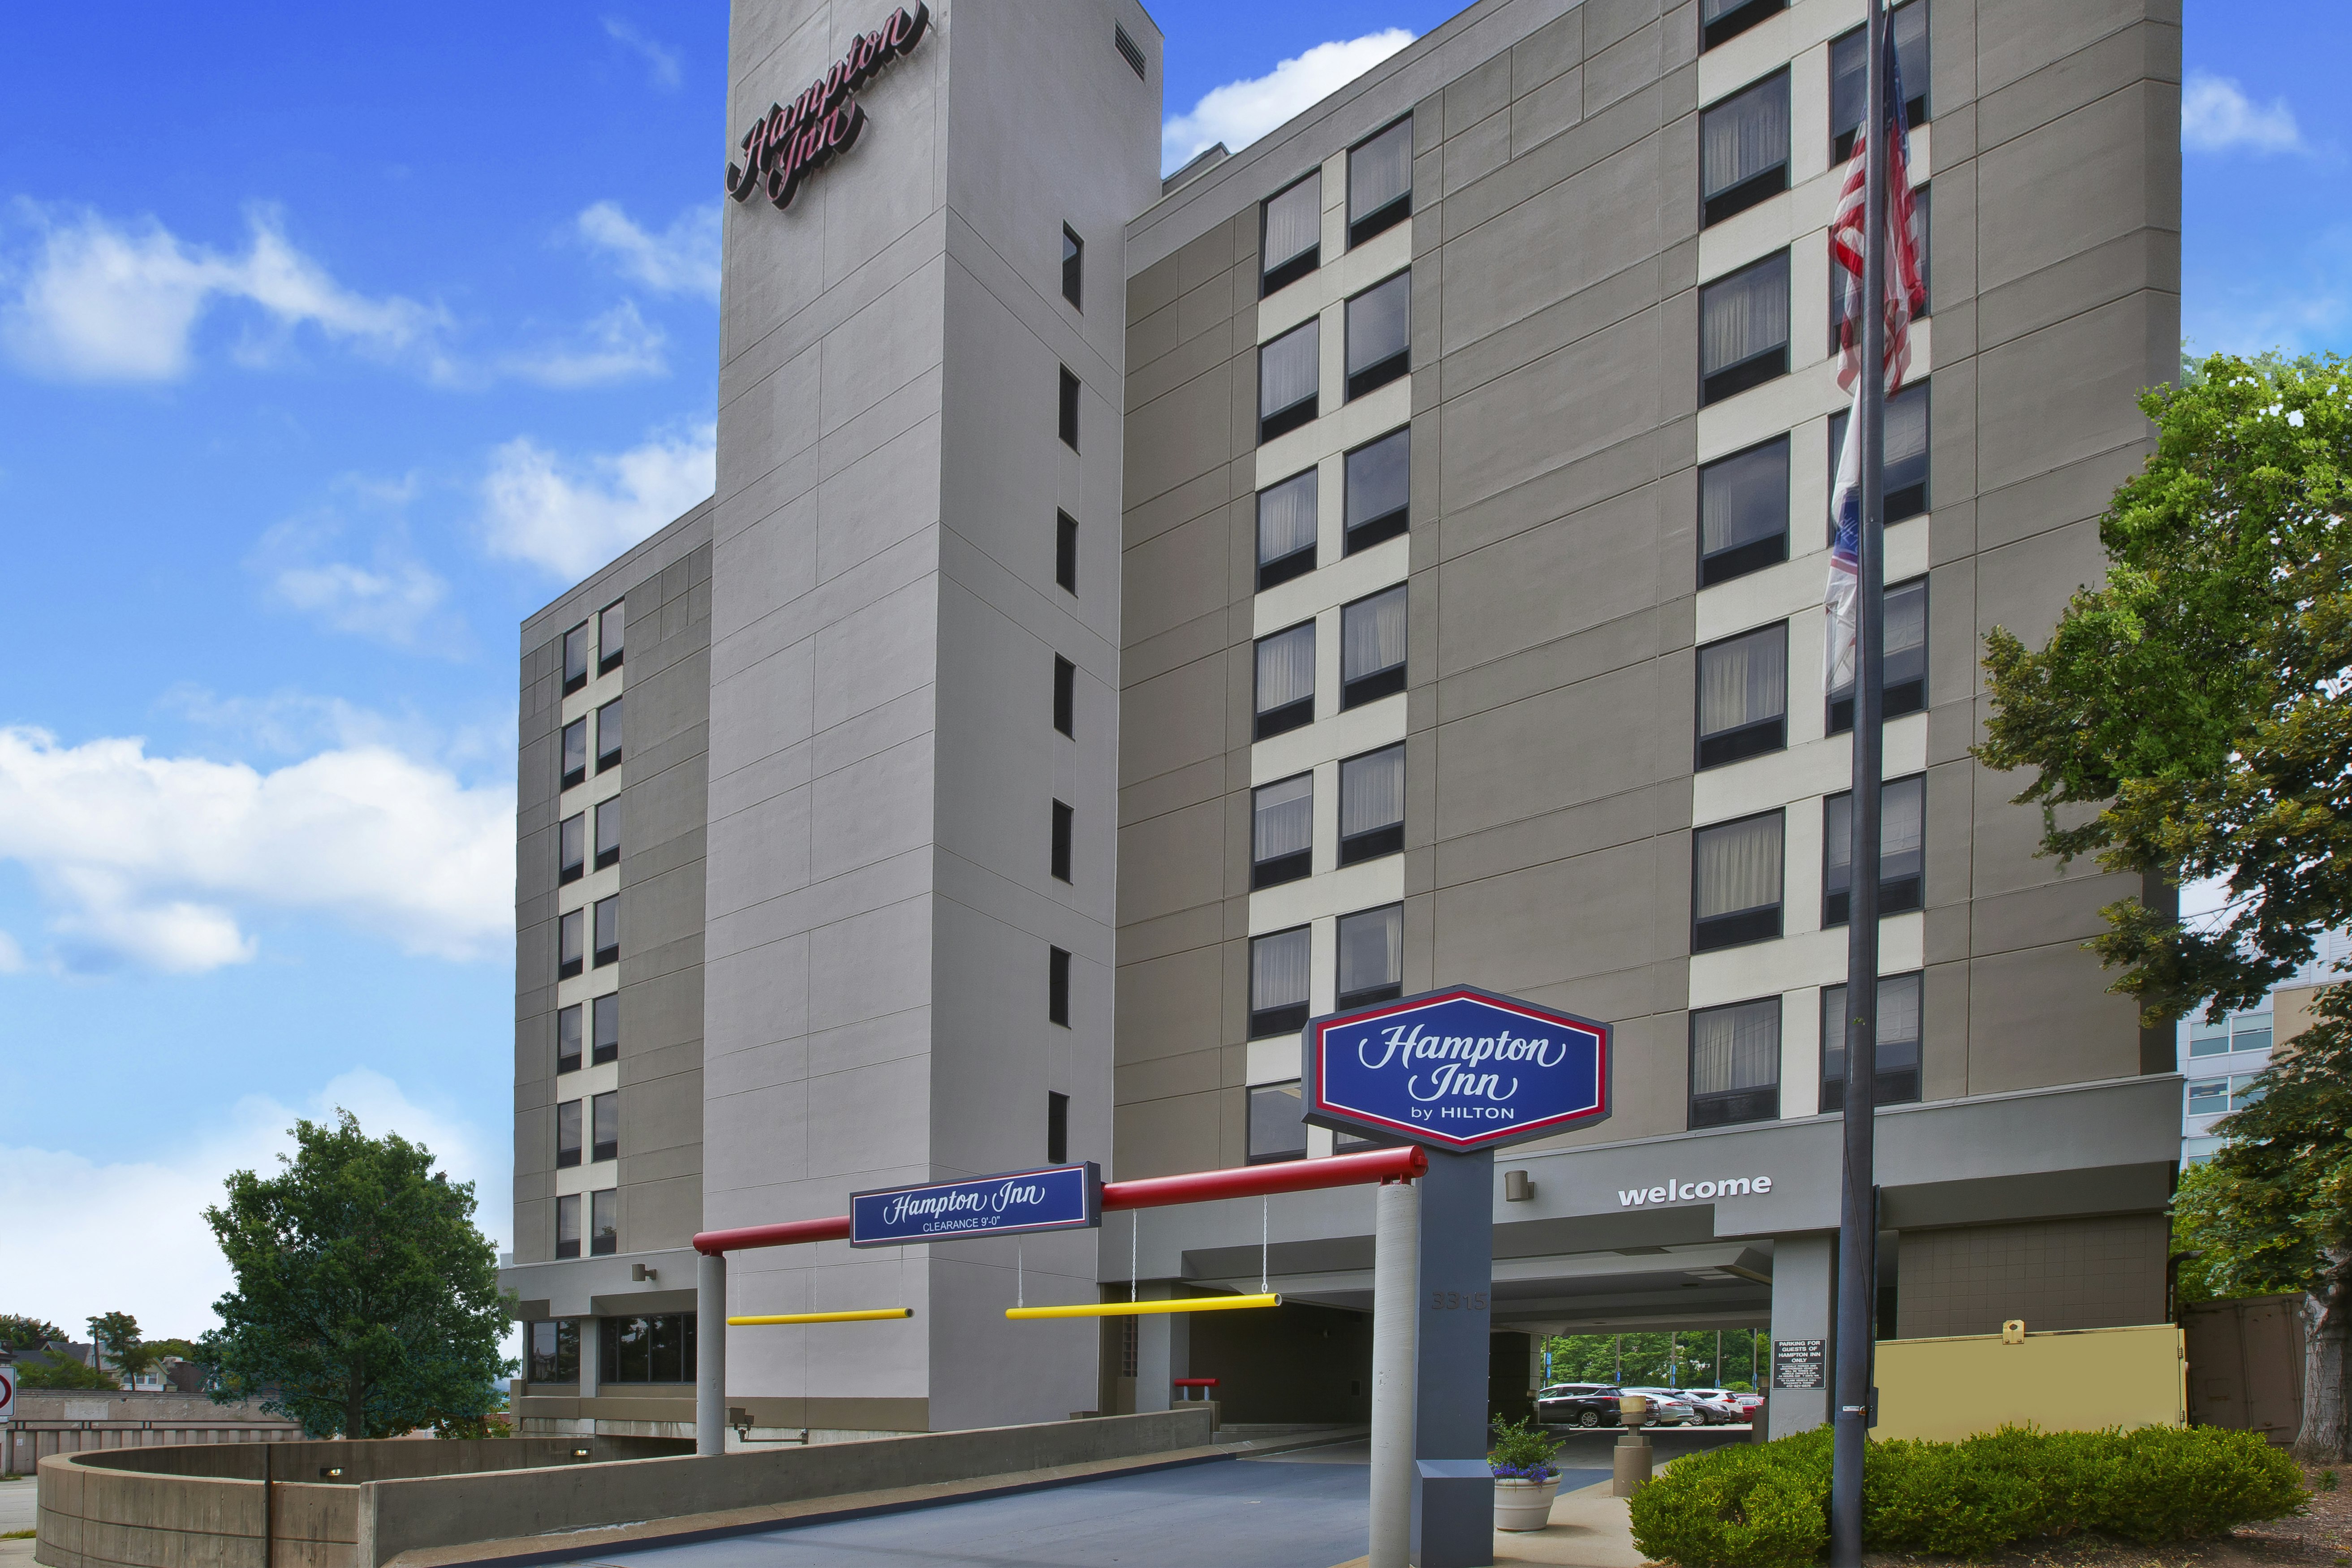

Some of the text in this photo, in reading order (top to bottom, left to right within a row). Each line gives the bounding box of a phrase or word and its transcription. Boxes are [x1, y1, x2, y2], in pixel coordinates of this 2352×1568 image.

[725, 0, 929, 202] Hampton
[766, 99, 864, 209] Inn
[1359, 1024, 1566, 1069] Hampton
[1408, 1063, 1518, 1101] Inn
[1411, 1107, 1514, 1120] by HILTON
[883, 1181, 1045, 1224] Hampton Inn
[1618, 1176, 1772, 1206] welcome
[923, 1218, 978, 1232] CLEARANCE
[1432, 1291, 1488, 1310] 3315
